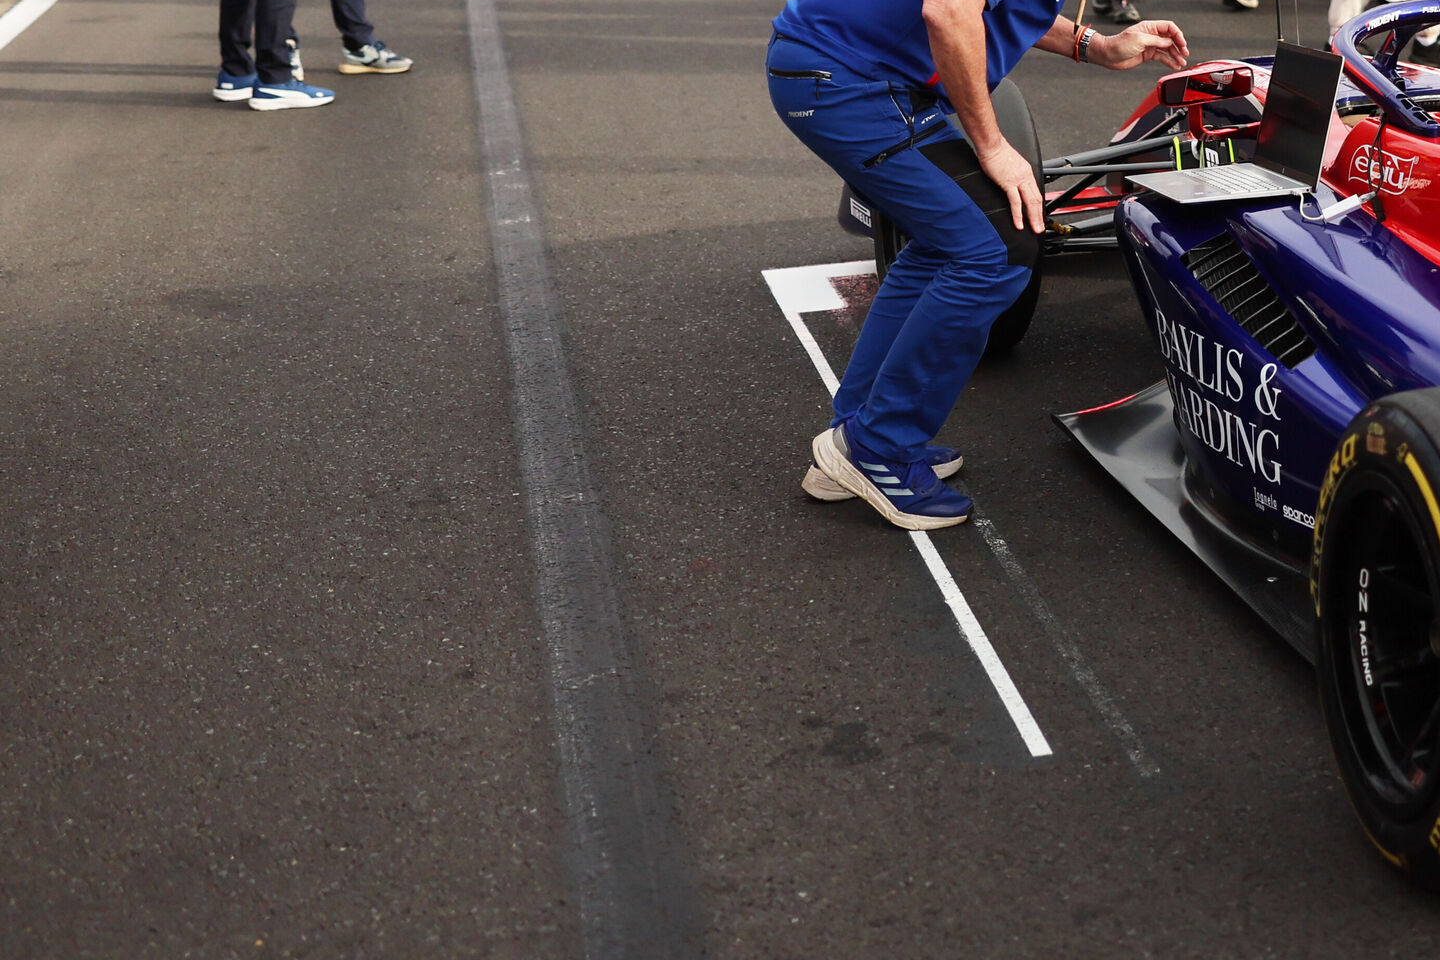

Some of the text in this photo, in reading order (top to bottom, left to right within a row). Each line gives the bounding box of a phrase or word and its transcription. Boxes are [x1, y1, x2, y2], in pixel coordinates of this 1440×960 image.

[1366, 10, 1401, 31] TRIDENT
[1155, 307, 1282, 421] BAYLIS &
[1165, 366, 1282, 485] HARDING
[1282, 504, 1316, 529] sparco
[1359, 620, 1373, 687] RACING
